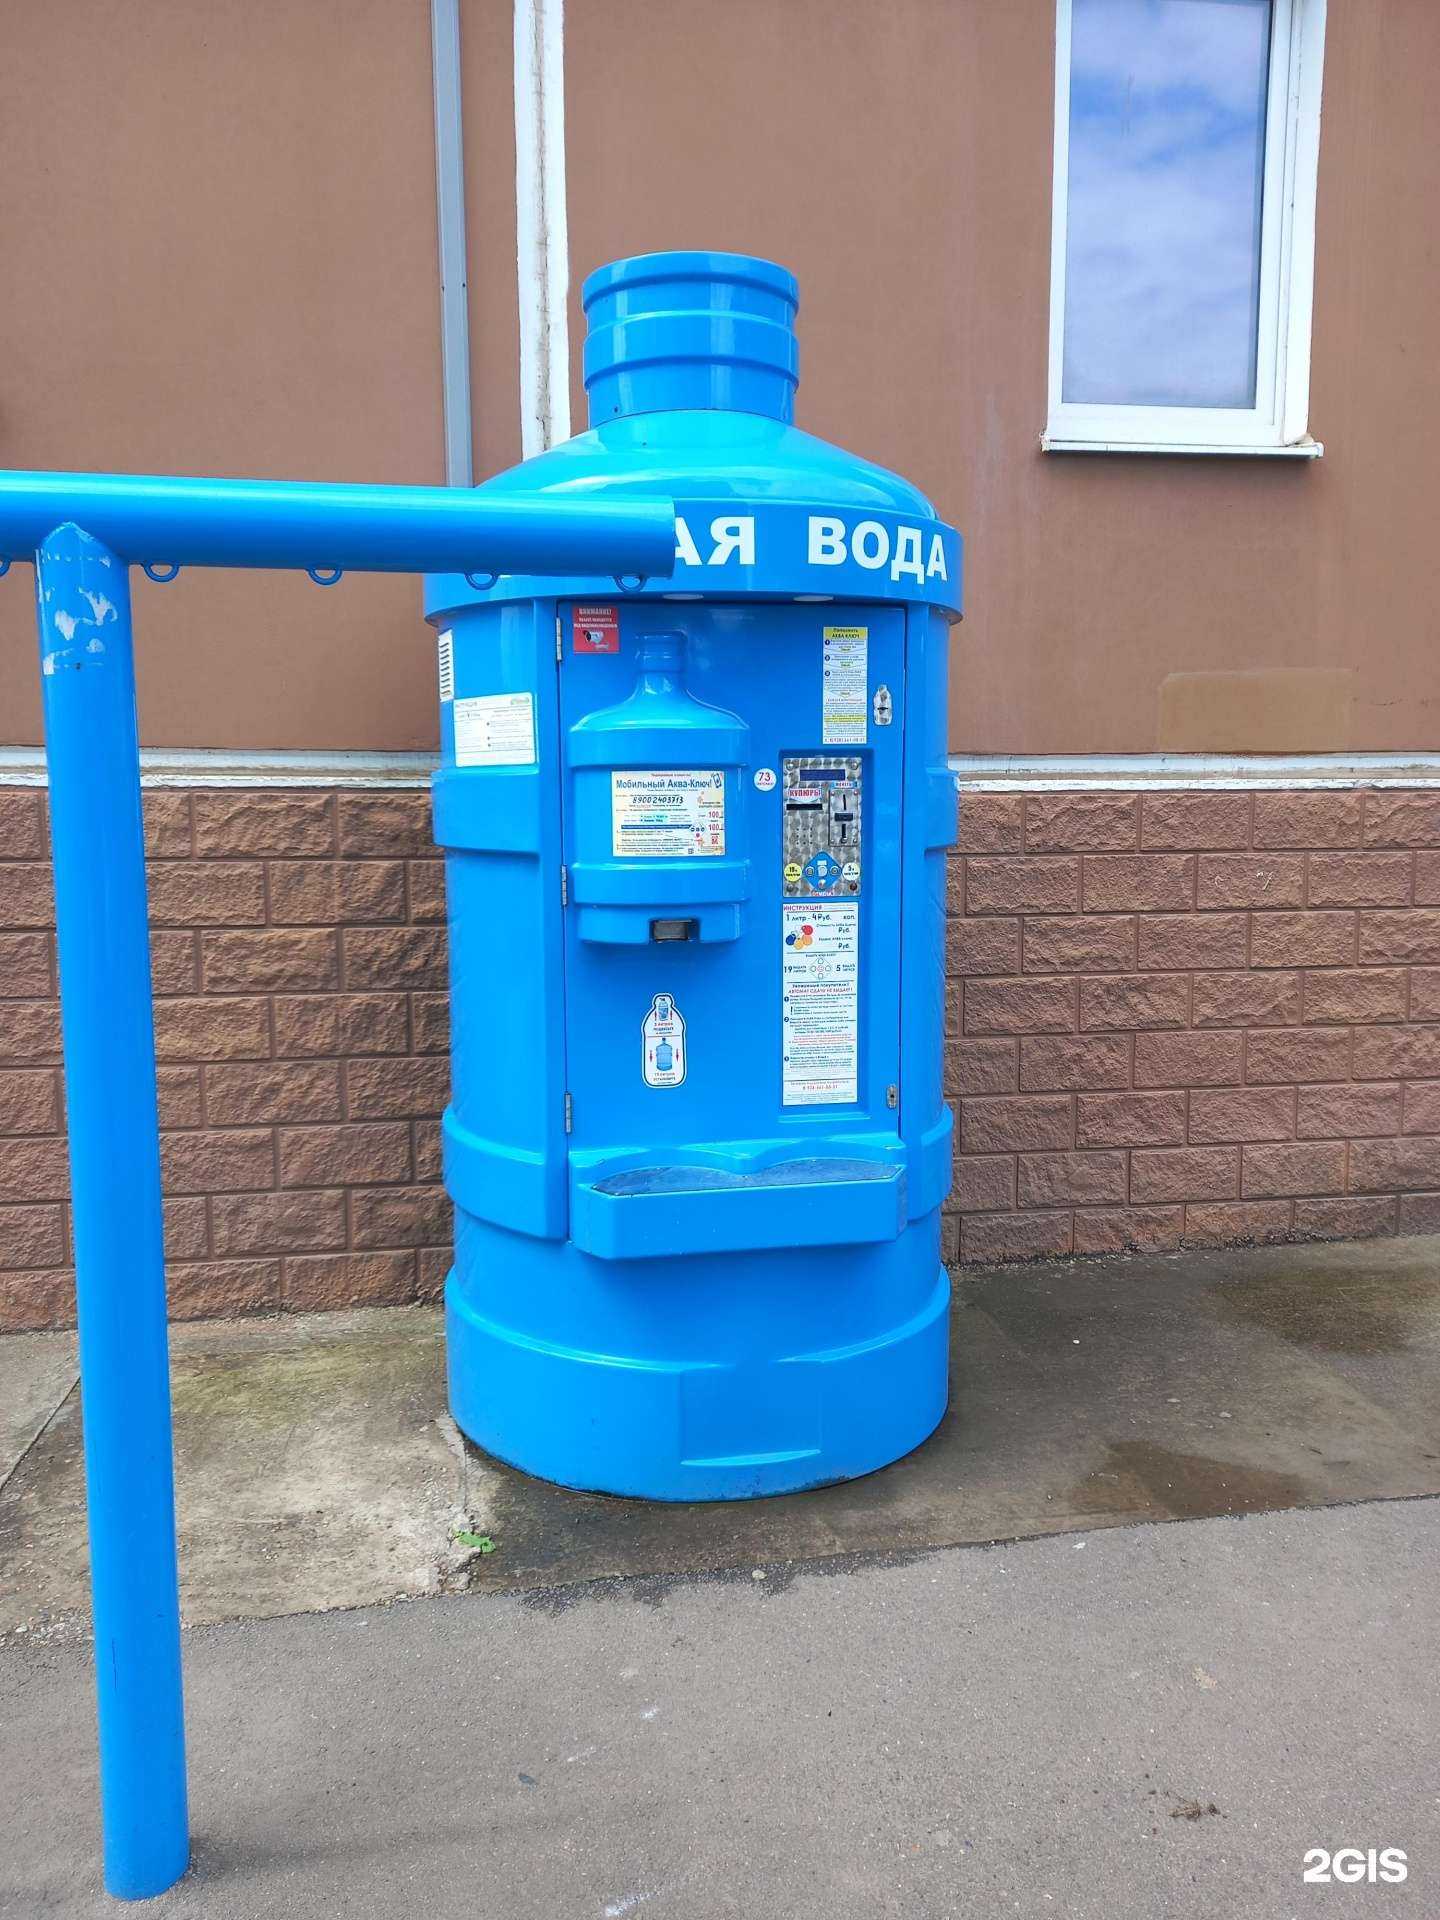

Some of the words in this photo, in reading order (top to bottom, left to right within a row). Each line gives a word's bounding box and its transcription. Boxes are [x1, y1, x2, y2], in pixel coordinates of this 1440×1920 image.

[807, 515, 949, 585] ВОДА
[759, 771, 771, 781] 73
[616, 779, 665, 788] Мобильный
[668, 778, 712, 788] Аква-Ключ!
[784, 965, 793, 973] 19
[836, 964, 841, 972] 5
